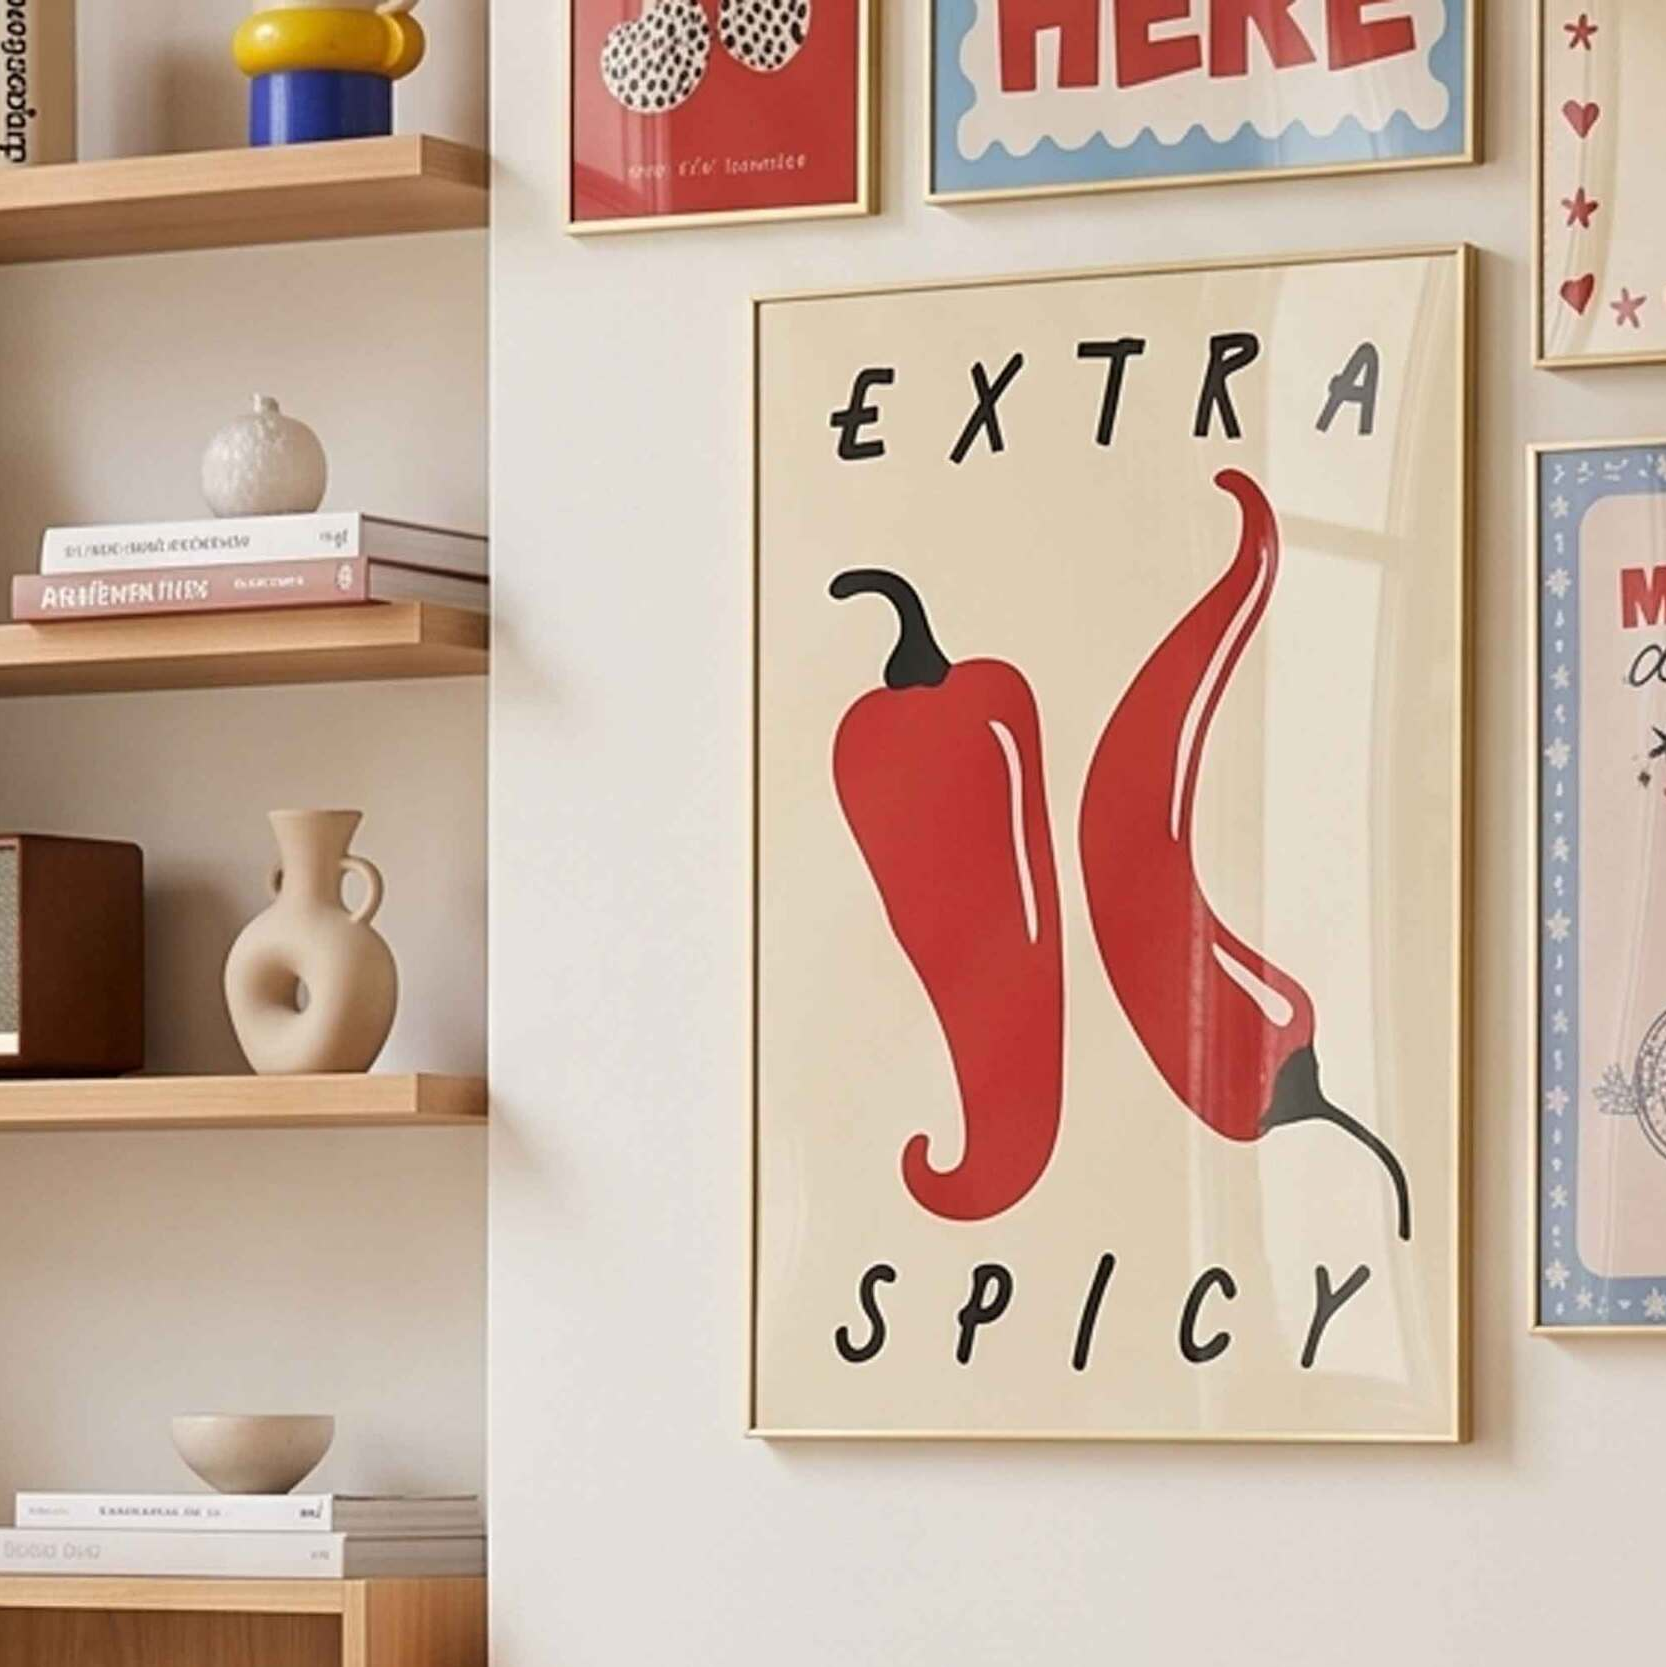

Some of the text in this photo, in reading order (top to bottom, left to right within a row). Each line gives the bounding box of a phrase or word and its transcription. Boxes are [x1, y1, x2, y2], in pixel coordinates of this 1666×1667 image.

[998, 0, 1416, 92] HERE
[829, 332, 1380, 464] EXTRA
[834, 1253, 1372, 1371] SPICY
